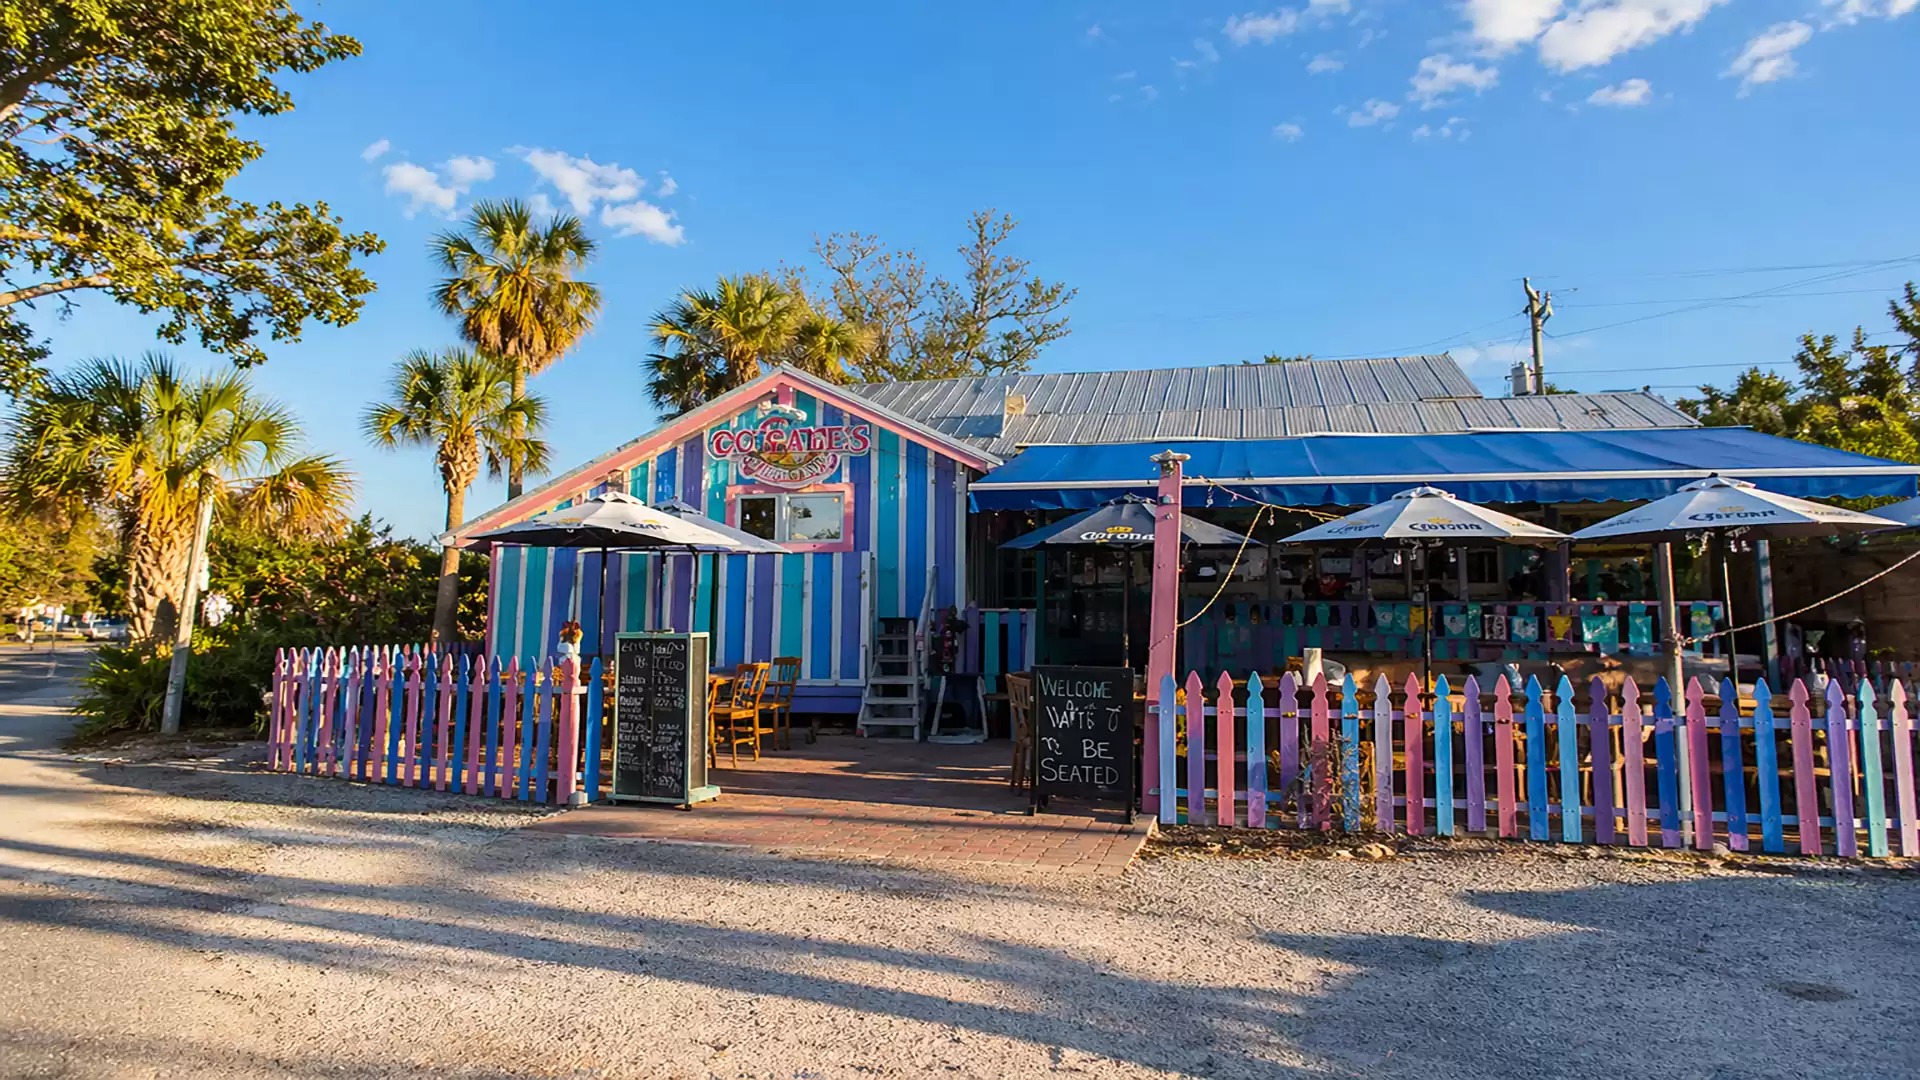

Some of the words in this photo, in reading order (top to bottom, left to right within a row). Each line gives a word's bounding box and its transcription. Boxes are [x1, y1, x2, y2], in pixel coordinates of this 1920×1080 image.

[1080, 531, 1155, 540] Corona
[1409, 523, 1483, 532] Corona
[1039, 674, 1113, 698] WELCOME
[1082, 738, 1114, 759] BE
[1041, 757, 1119, 784] SEATED
